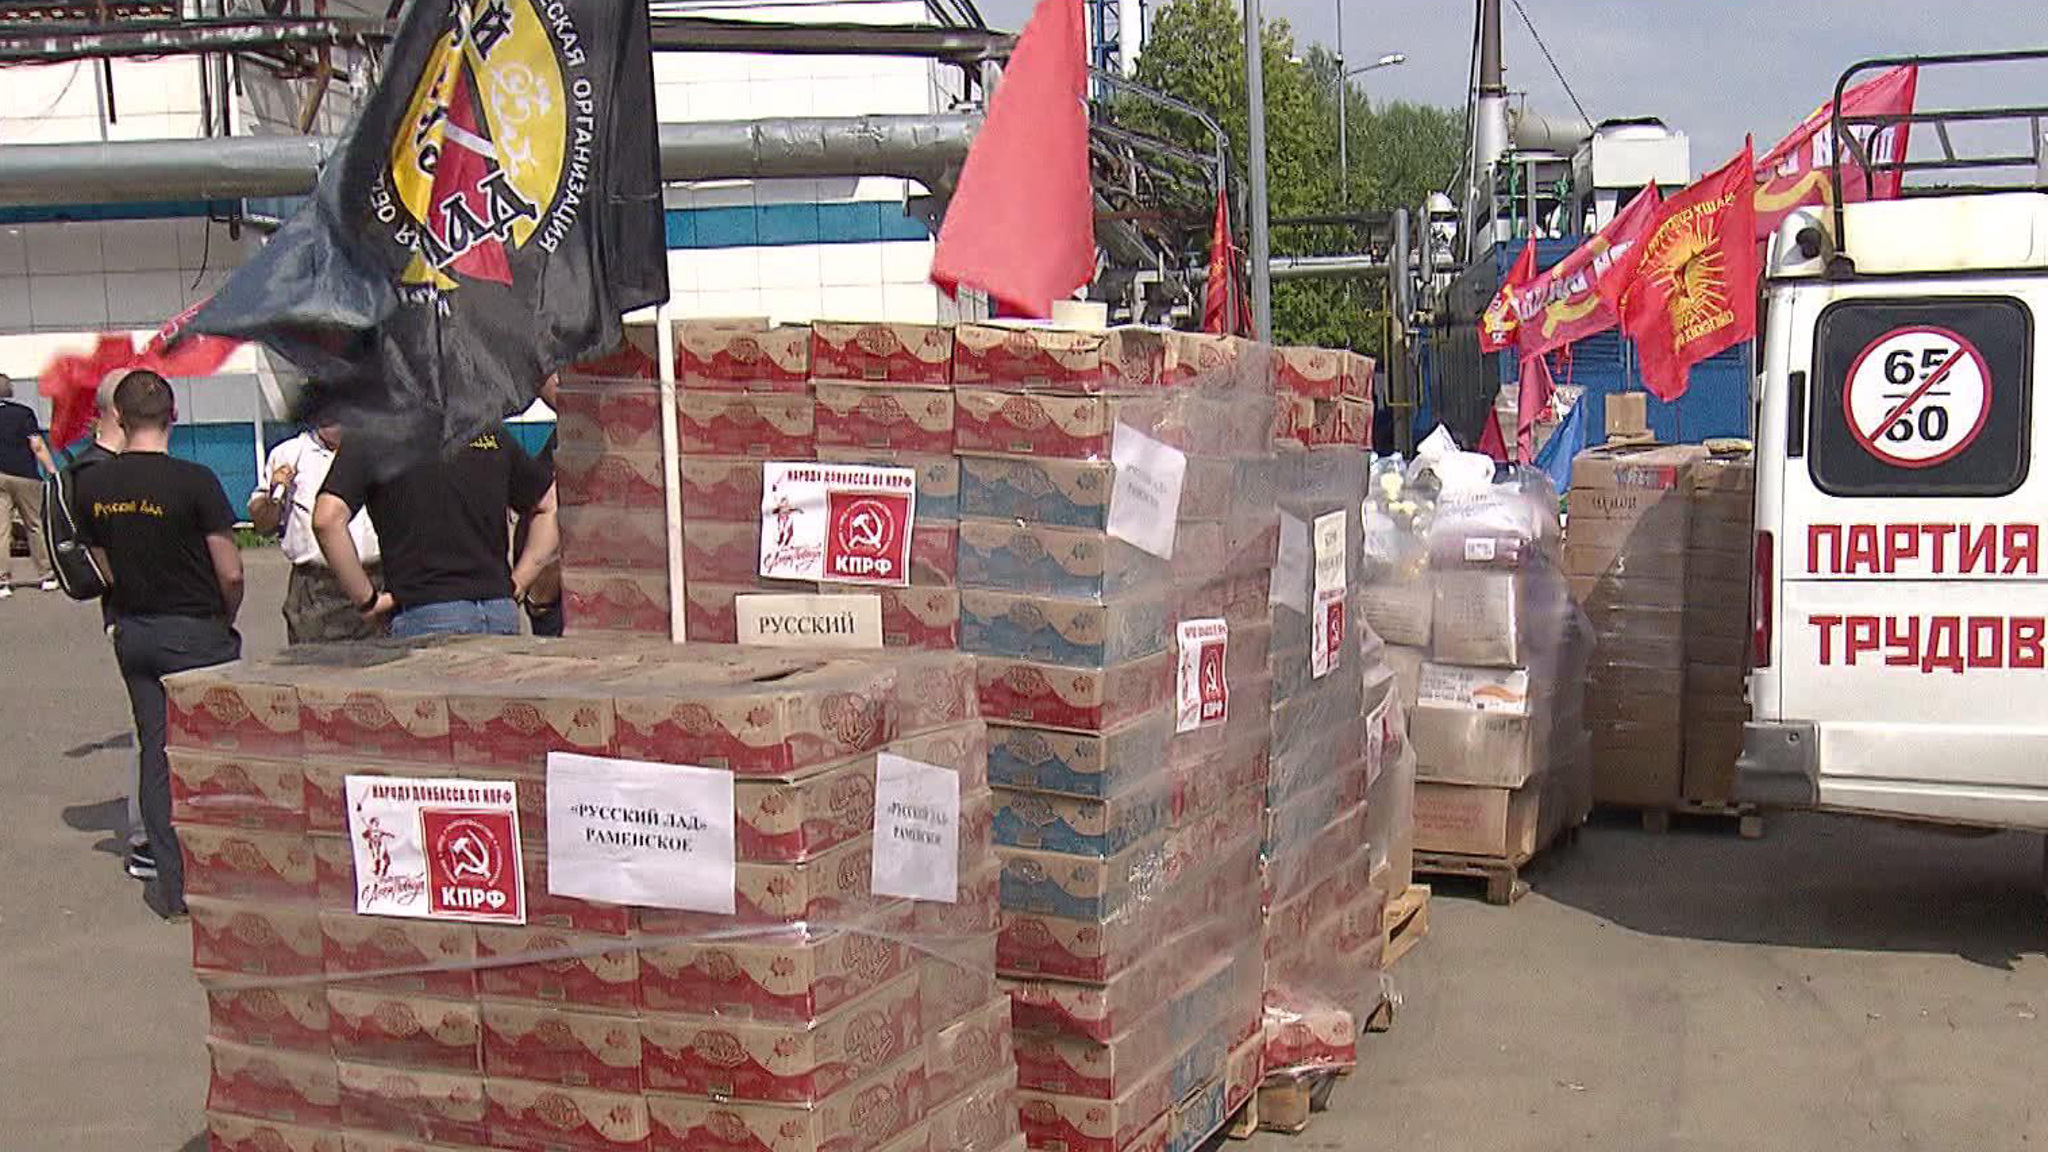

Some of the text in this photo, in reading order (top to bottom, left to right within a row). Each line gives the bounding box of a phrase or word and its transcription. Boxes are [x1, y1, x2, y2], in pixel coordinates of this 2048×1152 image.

[539, 0, 595, 253] СКАЯ ОРГАНИЗАЦИЯ
[1884, 348, 1950, 385] 65
[1885, 405, 1949, 442] 60
[1807, 524, 2040, 574] ПАРТИЯ
[835, 555, 893, 575] КПРФ
[759, 611, 856, 634] РУССКИЙ
[1808, 616, 2045, 674] ТРУДОВ
[372, 784, 513, 804] НАРОДУ ДОНБАССА ОТ КПРФ
[570, 803, 659, 826] «РУССКИЙ
[586, 827, 694, 853] РАМЕНСКОЕ
[441, 886, 507, 910] КПРФ
